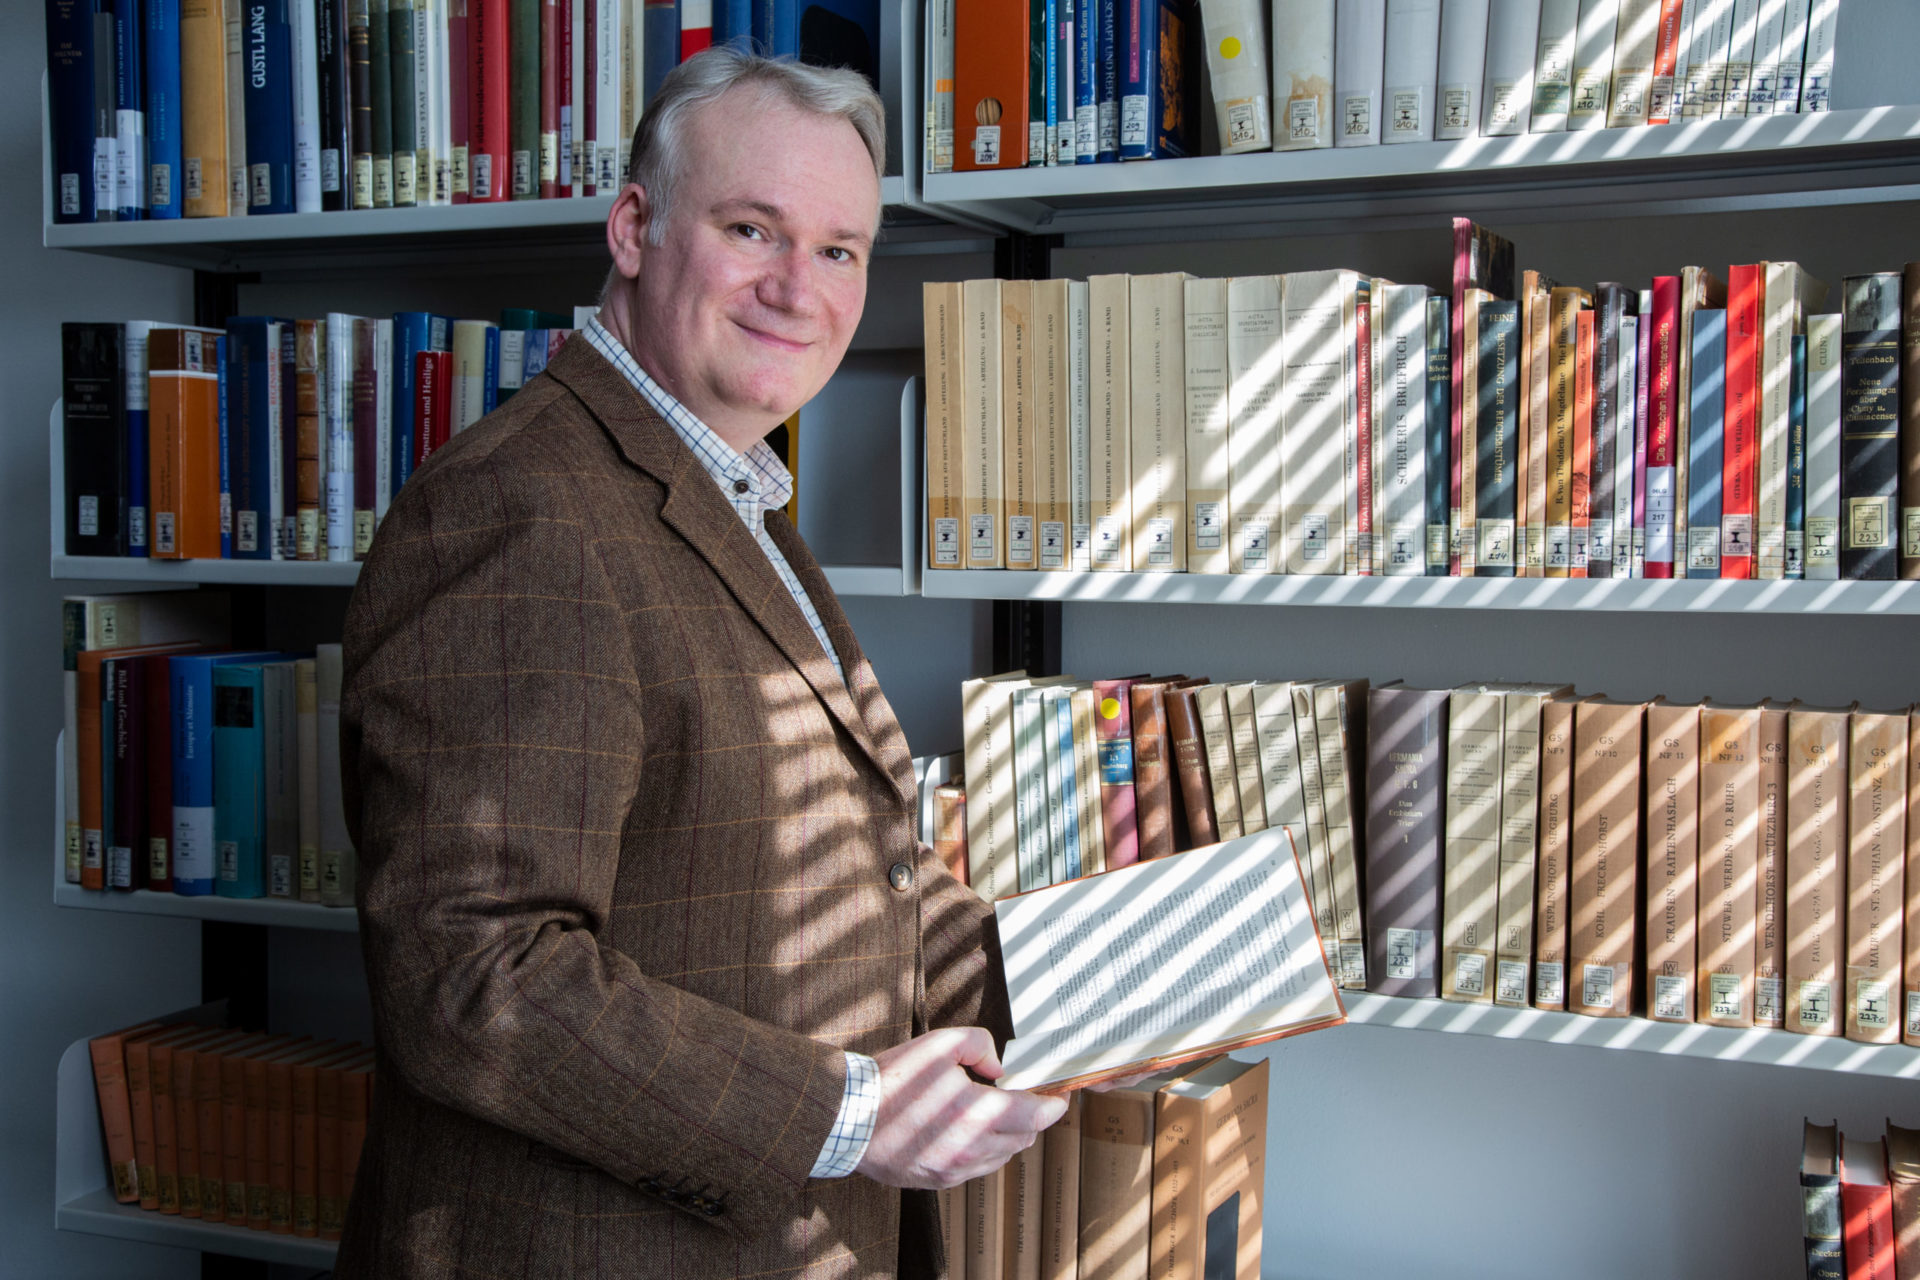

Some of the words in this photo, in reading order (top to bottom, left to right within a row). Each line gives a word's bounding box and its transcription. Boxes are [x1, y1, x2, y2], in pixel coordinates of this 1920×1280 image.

[251, 6, 265, 43] LANG
[1079, 9, 1090, 38] Reform
[1662, 16, 1674, 60] territoriale
[251, 46, 266, 88] GUSTL
[1079, 40, 1090, 84] Katholische
[1104, 45, 1114, 70] UND
[1660, 62, 1669, 76] Die
[418, 91, 426, 122] STAAT
[1154, 307, 1162, 326] BAND
[1489, 312, 1515, 323] FEINE
[1557, 297, 1568, 349] Hugenotten
[979, 346, 987, 382] ABTEILUNG
[1495, 332, 1505, 384] BESETZUNG
[1556, 349, 1565, 365] Die
[1658, 322, 1670, 399] Hugenottenstädte
[1819, 334, 1828, 366] CLUNY
[421, 357, 434, 394] Heilige
[1360, 343, 1370, 413] REFORMATION
[1395, 336, 1409, 408] BRIEFBUCH
[1859, 378, 1881, 386] Neue
[423, 396, 431, 415] und
[1495, 387, 1505, 405] DER
[1556, 372, 1568, 426] Magdelaine
[1846, 387, 1897, 396] Forschungen
[1048, 391, 1056, 439] DEUTSCHLAND
[1656, 401, 1667, 445] deutschen
[1850, 405, 1874, 413] Cluny
[1360, 416, 1370, 441] UND
[980, 447, 988, 460] AUS
[1396, 412, 1409, 485] SCHEUERLS
[1493, 410, 1505, 484] REICHSBISTÜMER
[1656, 447, 1666, 462] Die
[1859, 533, 1880, 542] 223
[118, 669, 127, 688] Bild
[118, 689, 127, 708] und
[118, 709, 128, 760] Geschichte
[1548, 733, 1563, 743] GS
[1598, 736, 1614, 745] GS
[1663, 738, 1680, 748] GS
[1723, 741, 1739, 750] GS
[1765, 743, 1782, 753] GS
[1659, 752, 1673, 760] NF
[1676, 752, 1685, 760] 11
[1718, 754, 1733, 762] NF
[1735, 754, 1745, 762] 12
[1811, 745, 1826, 754] GS
[1871, 748, 1887, 758] GS
[985, 757, 993, 794] Geschichte
[1724, 783, 1735, 813] RUHR
[1871, 777, 1883, 837] KONSTANZ
[1548, 793, 1559, 846] SIEGBURG
[1666, 778, 1676, 877] RAITENHASLACH
[1725, 816, 1734, 827] D.
[1764, 792, 1777, 858] WÜRZBURG
[1724, 830, 1734, 840] A.
[1597, 814, 1608, 897] FRECKENHORST
[1723, 844, 1734, 890] WERDEN
[1871, 843, 1881, 894] STEPHAN
[1546, 856, 1557, 933] WISPLINGHOFF
[1765, 868, 1776, 949] WENDEHORST
[1870, 897, 1881, 912] ST.
[1596, 909, 1606, 938] KOHL
[1666, 888, 1676, 943] KRAUSEN
[1722, 900, 1733, 943] STÜWER
[1869, 923, 1880, 969] MAURER
[1801, 1012, 1818, 1021] 227
[1858, 1012, 1877, 1022] 227
[1172, 1124, 1183, 1133] GS
